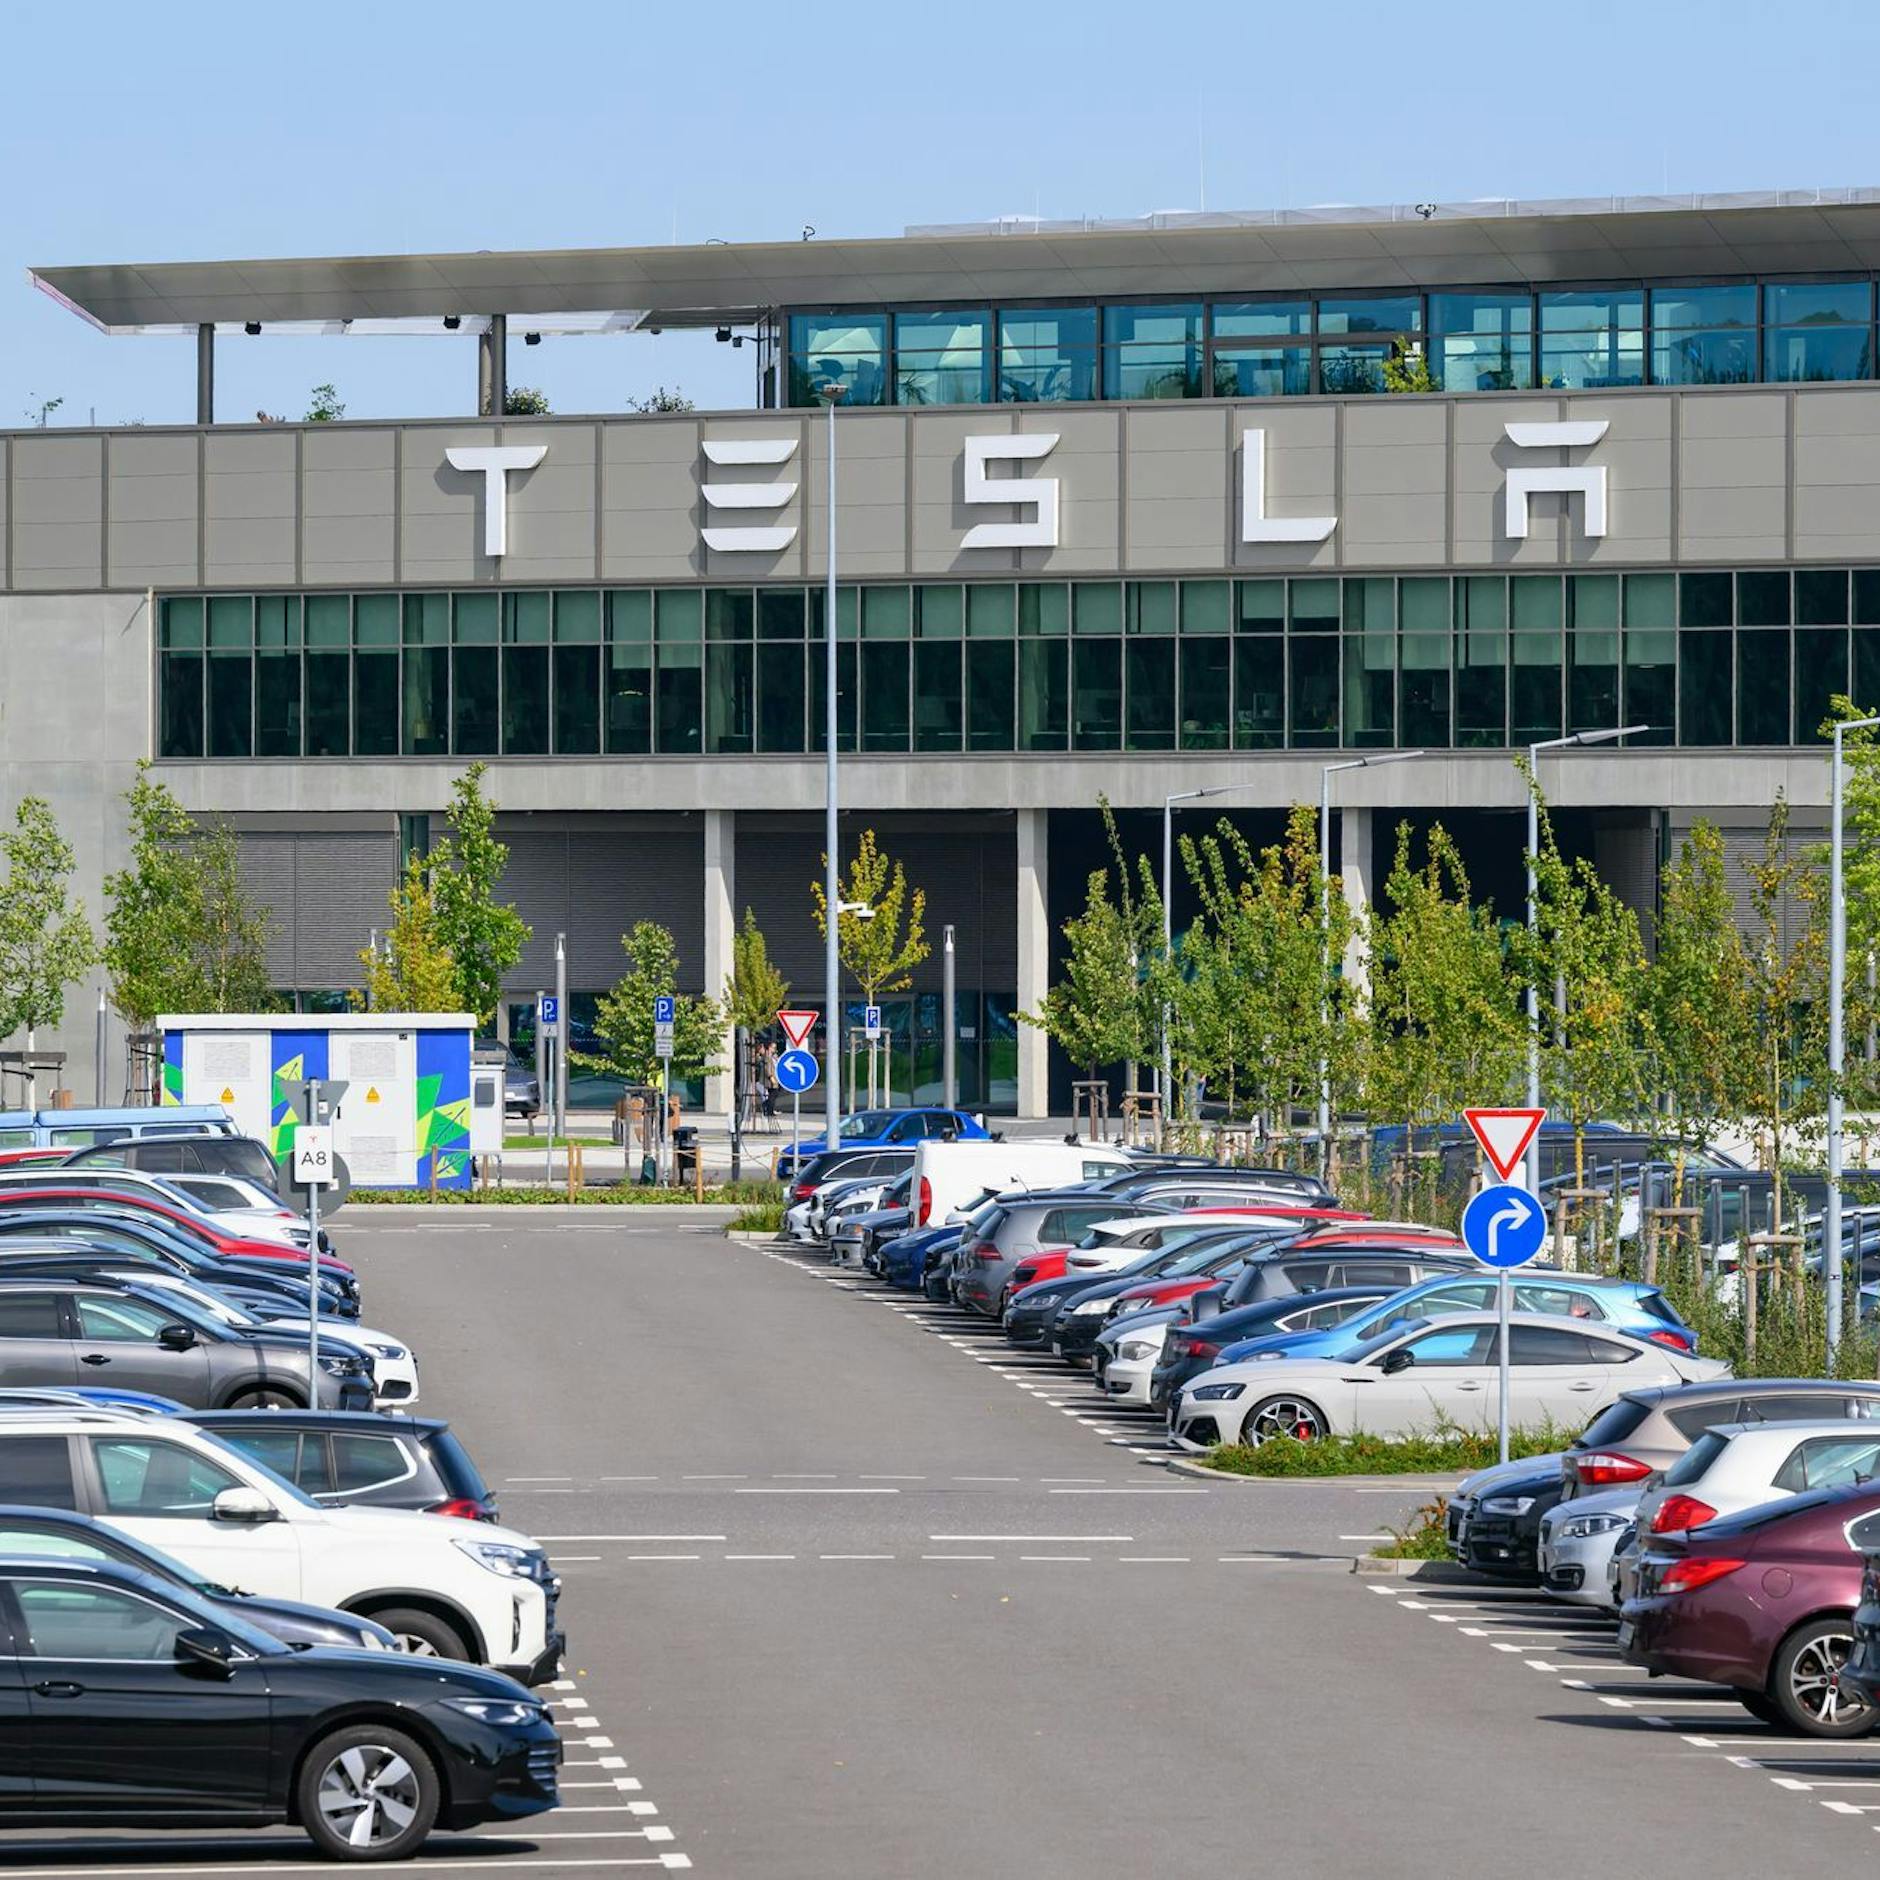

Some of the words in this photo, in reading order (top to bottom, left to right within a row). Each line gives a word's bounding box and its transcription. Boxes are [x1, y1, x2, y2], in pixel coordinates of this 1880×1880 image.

[445, 420, 1610, 557] TESLA
[543, 1000, 555, 1020] P
[658, 1000, 669, 1020] P
[301, 1151, 327, 1166] A8
